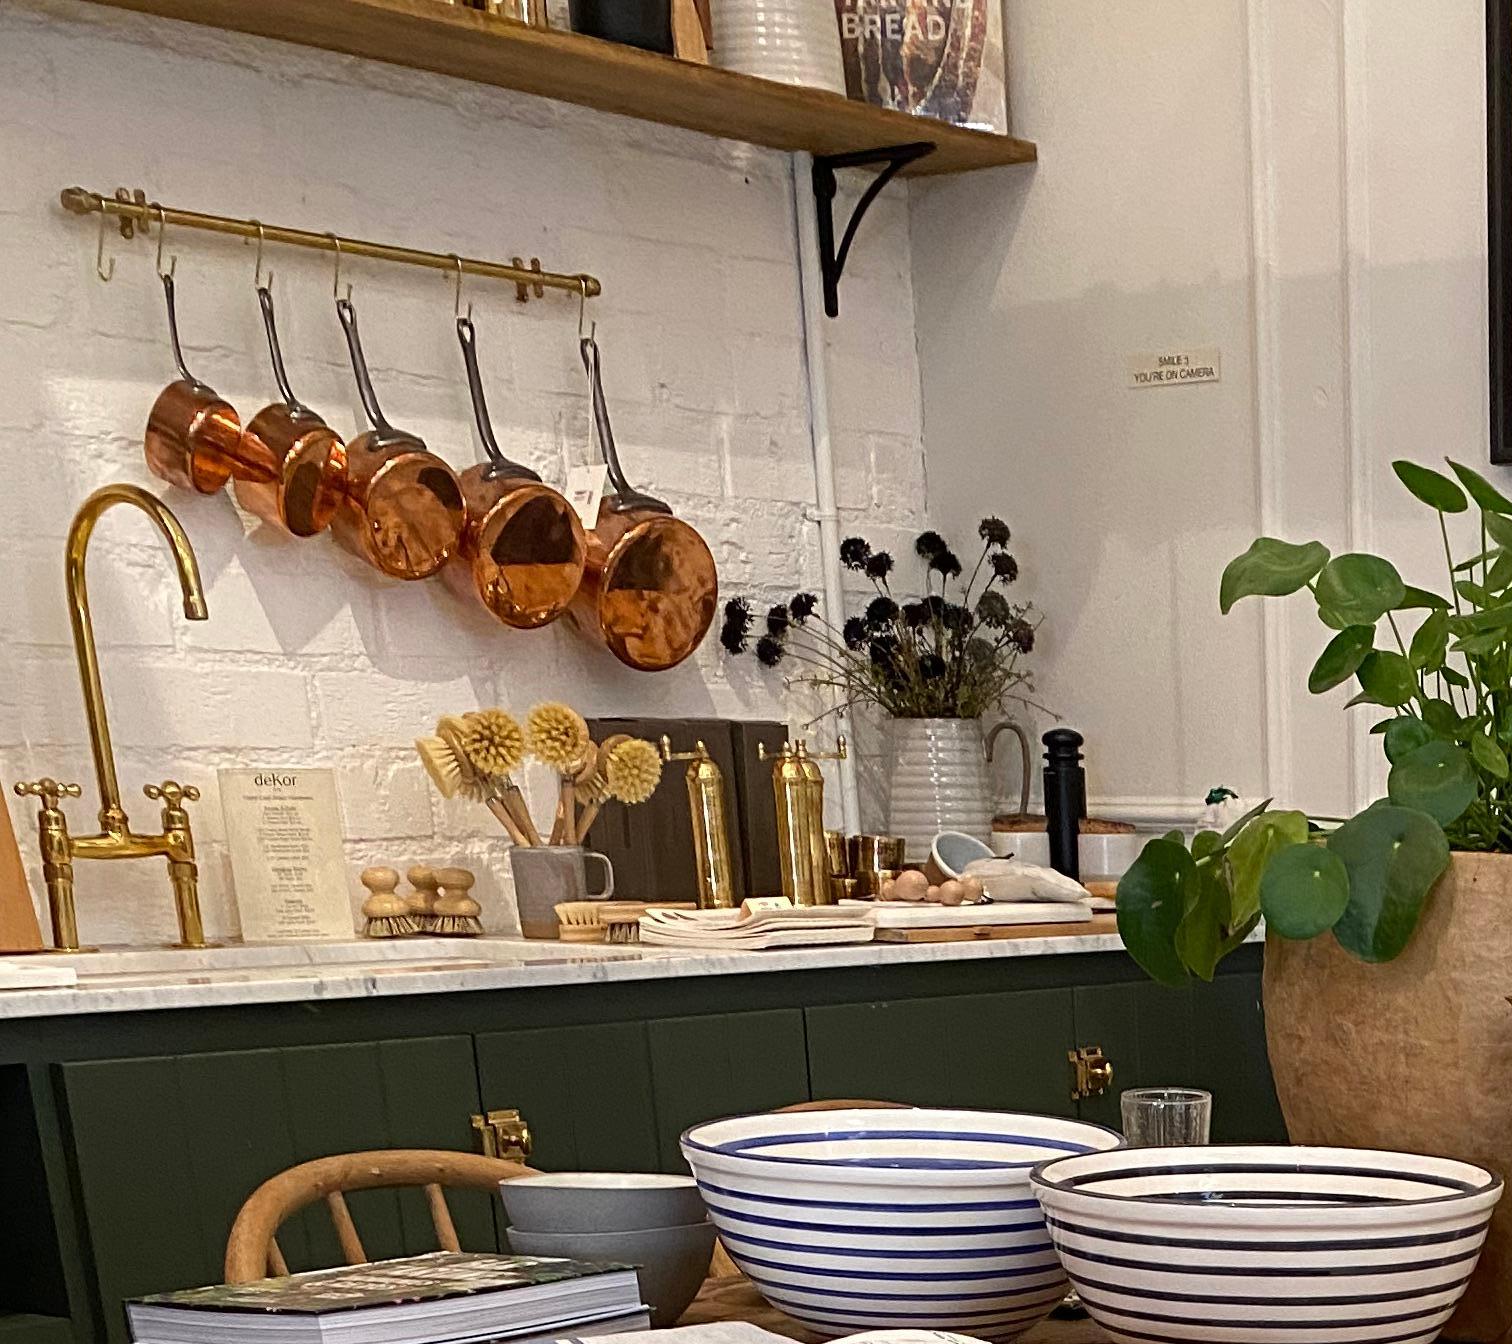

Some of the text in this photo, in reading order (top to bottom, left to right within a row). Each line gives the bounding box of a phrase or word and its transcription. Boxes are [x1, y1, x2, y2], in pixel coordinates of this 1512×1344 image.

[841, 12, 947, 41] BREAD
[1158, 355, 1183, 366] SMILE
[1133, 366, 1216, 383] YOU'RE ON CAMERA
